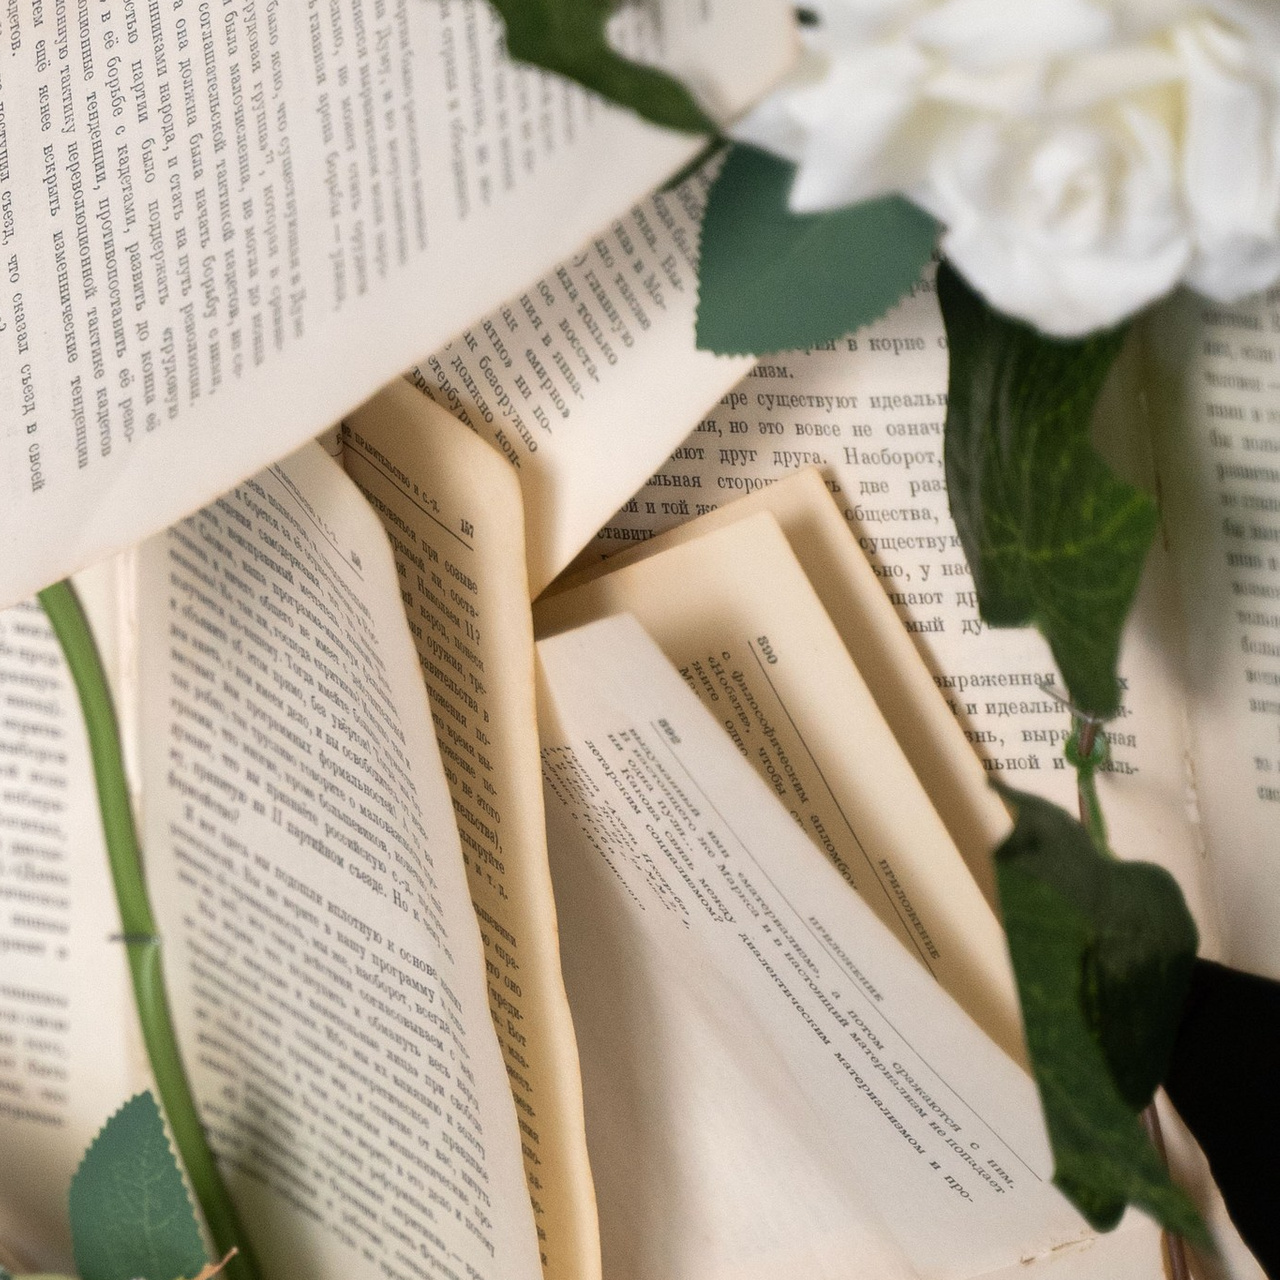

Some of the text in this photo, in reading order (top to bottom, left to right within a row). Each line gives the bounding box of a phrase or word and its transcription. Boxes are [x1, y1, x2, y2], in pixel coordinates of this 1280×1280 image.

[35, 39, 47, 73] ещё
[38, 84, 51, 132] яснее
[60, 64, 75, 133] тактику
[129, 59, 149, 123] партии
[141, 138, 156, 183] было
[42, 144, 61, 217] вскрыть
[1, 190, 14, 241] съезд,
[65, 141, 98, 300] нереволюционной
[8, 254, 20, 283] что
[53, 230, 78, 363] изменнические
[12, 292, 29, 355] сказал
[847, 338, 924, 355] в корне
[20, 364, 36, 416] съезд
[450, 355, 493, 424] должно
[479, 355, 538, 453] безоружно
[525, 349, 570, 418] «мирно»
[757, 393, 856, 411] существуют
[26, 422, 37, 434] в
[70, 375, 88, 469] тенденции
[728, 421, 872, 437] но это вовсе не
[28, 443, 45, 492] своей
[719, 446, 944, 469] друг друга. Наоборот,
[860, 481, 888, 495] две
[422, 542, 478, 595] при созыве
[721, 651, 809, 804] с философическим
[757, 635, 941, 960] 890 ПРИЛОЖЕНИЕ
[584, 740, 724, 922] летарским социализмом?
[621, 768, 660, 822] Какова
[699, 878, 736, 923] между
[738, 933, 831, 1045] диалектическим
[834, 1052, 926, 1154] материализмом
[929, 1161, 941, 1170] и
[944, 1175, 973, 1202] про-
[847, 1010, 1014, 1189] потом сражаются с ним.
